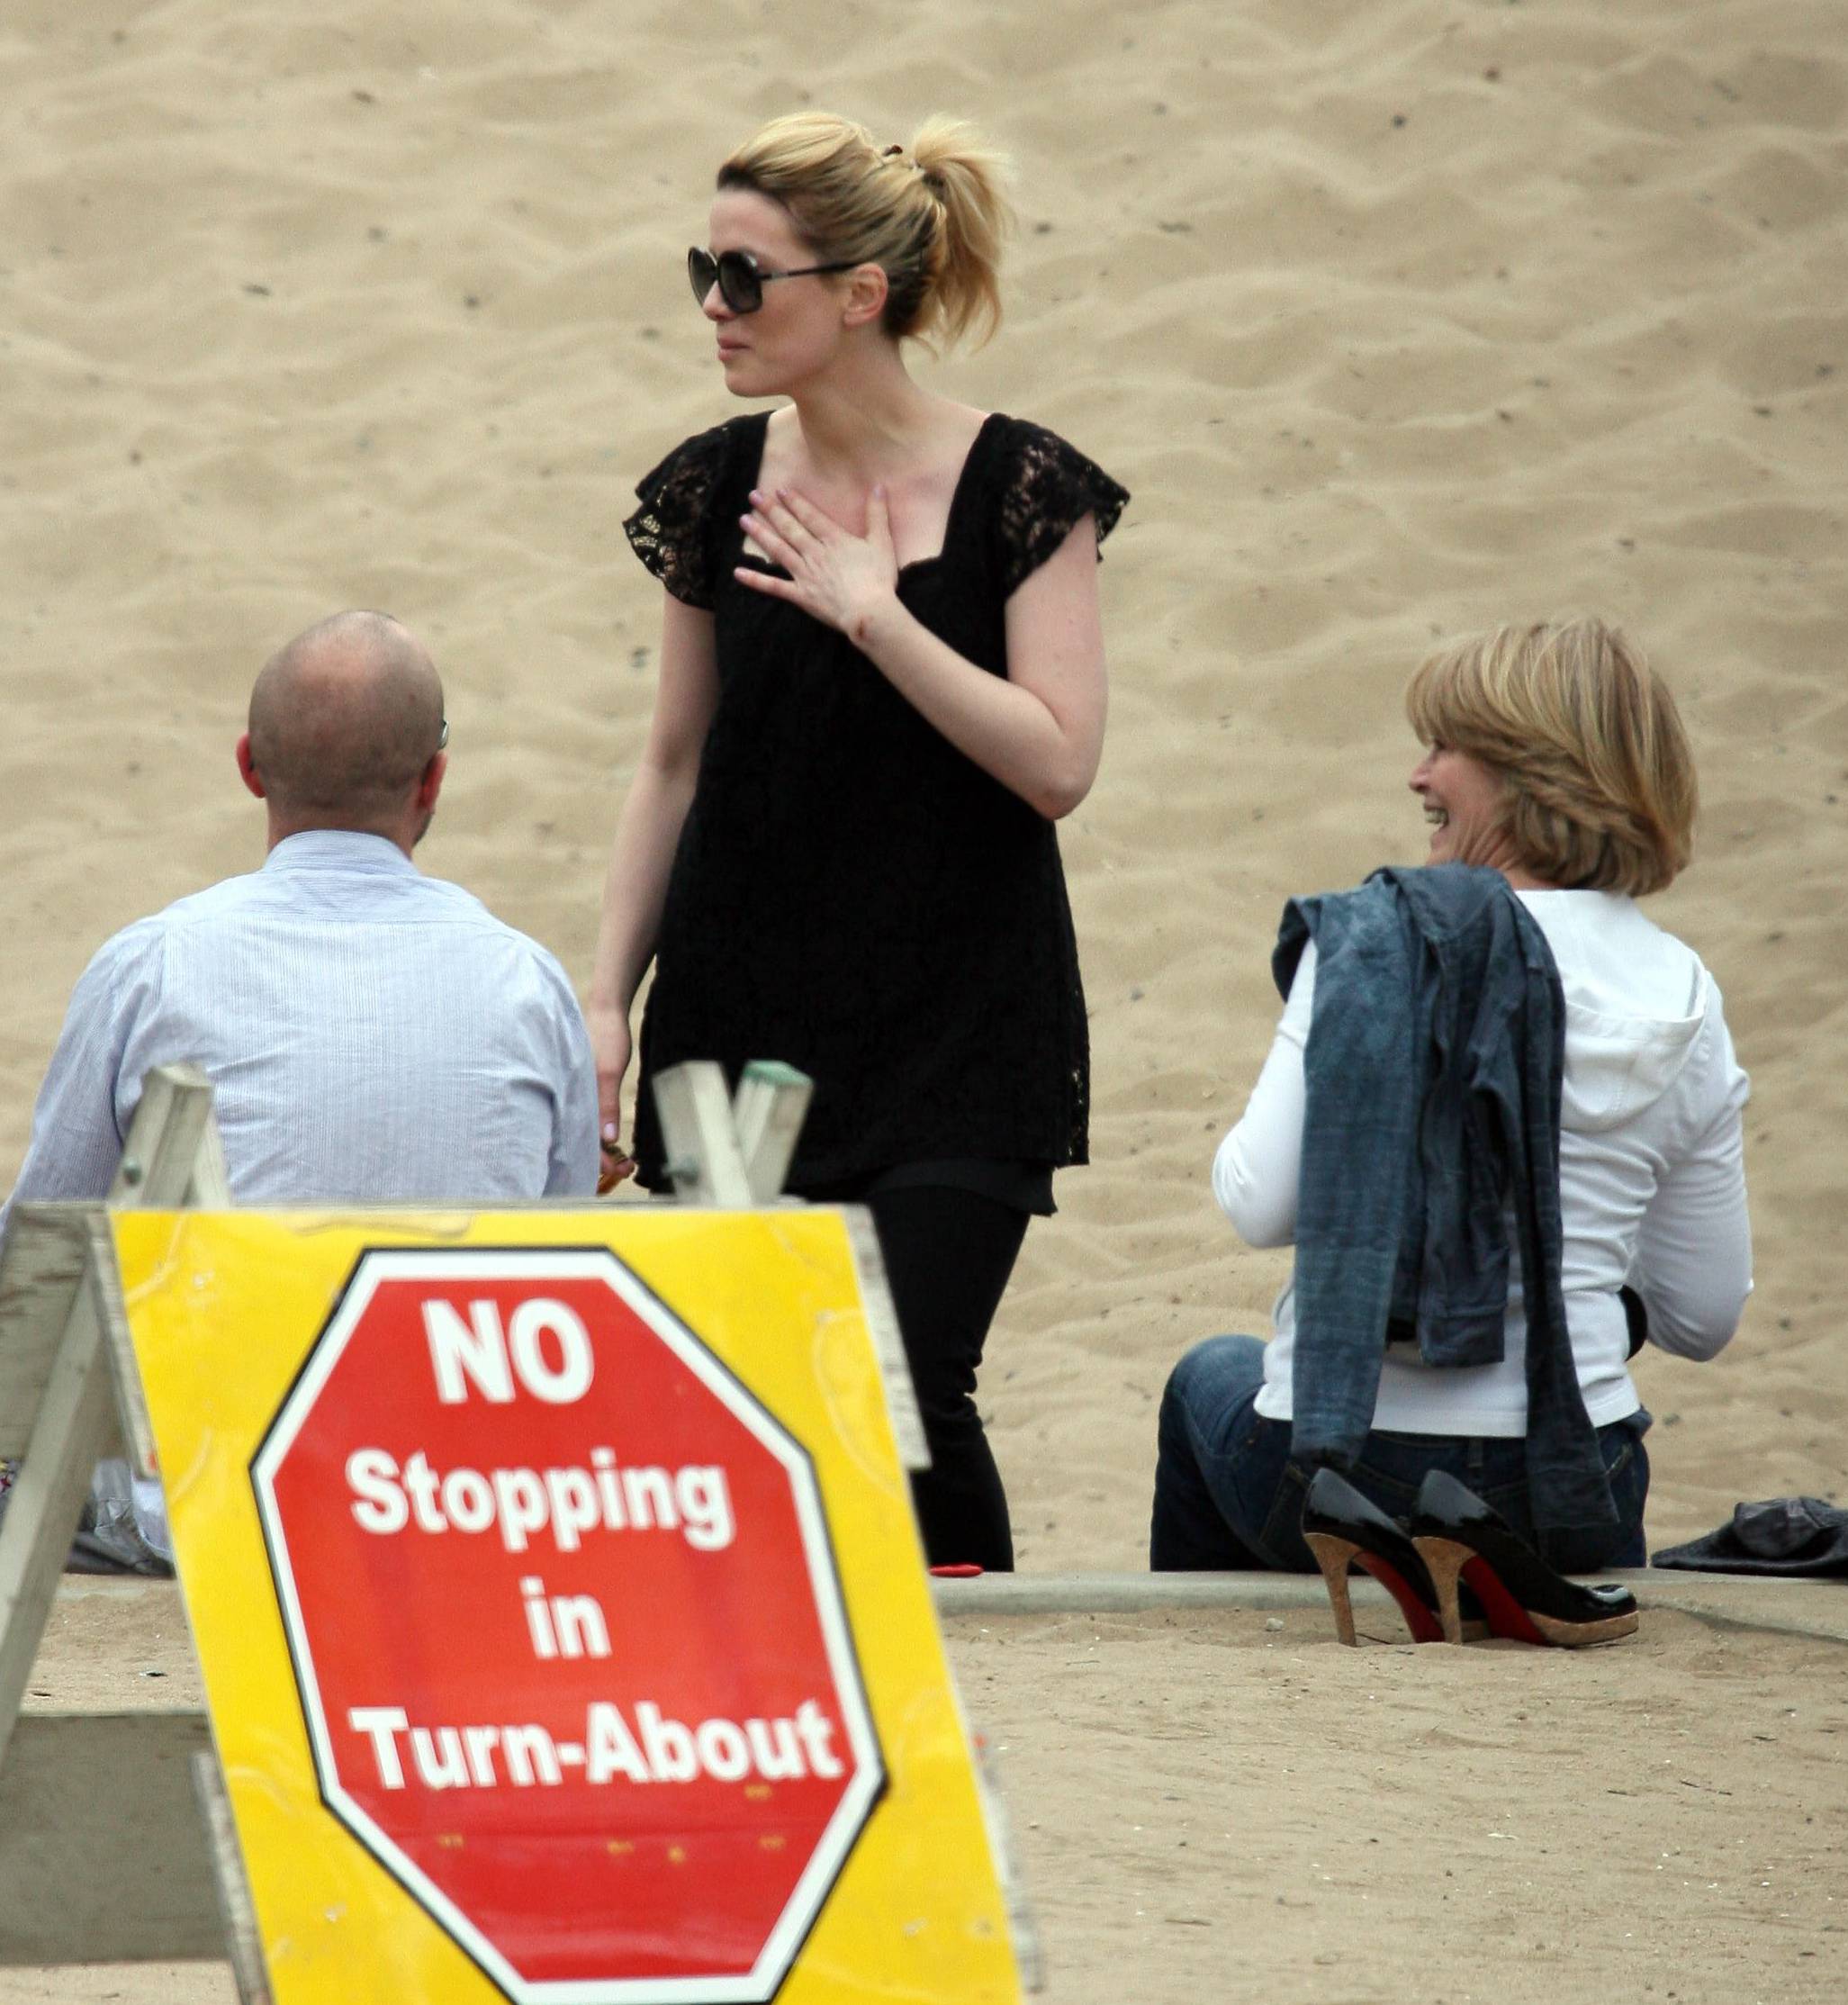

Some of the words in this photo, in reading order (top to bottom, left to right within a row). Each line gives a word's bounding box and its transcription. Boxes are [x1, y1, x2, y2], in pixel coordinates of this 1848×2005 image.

[421, 1297, 595, 1404] NO
[345, 1447, 735, 1552] Stopping
[520, 1576, 611, 1659] in
[347, 1700, 844, 1791] Turn-About
